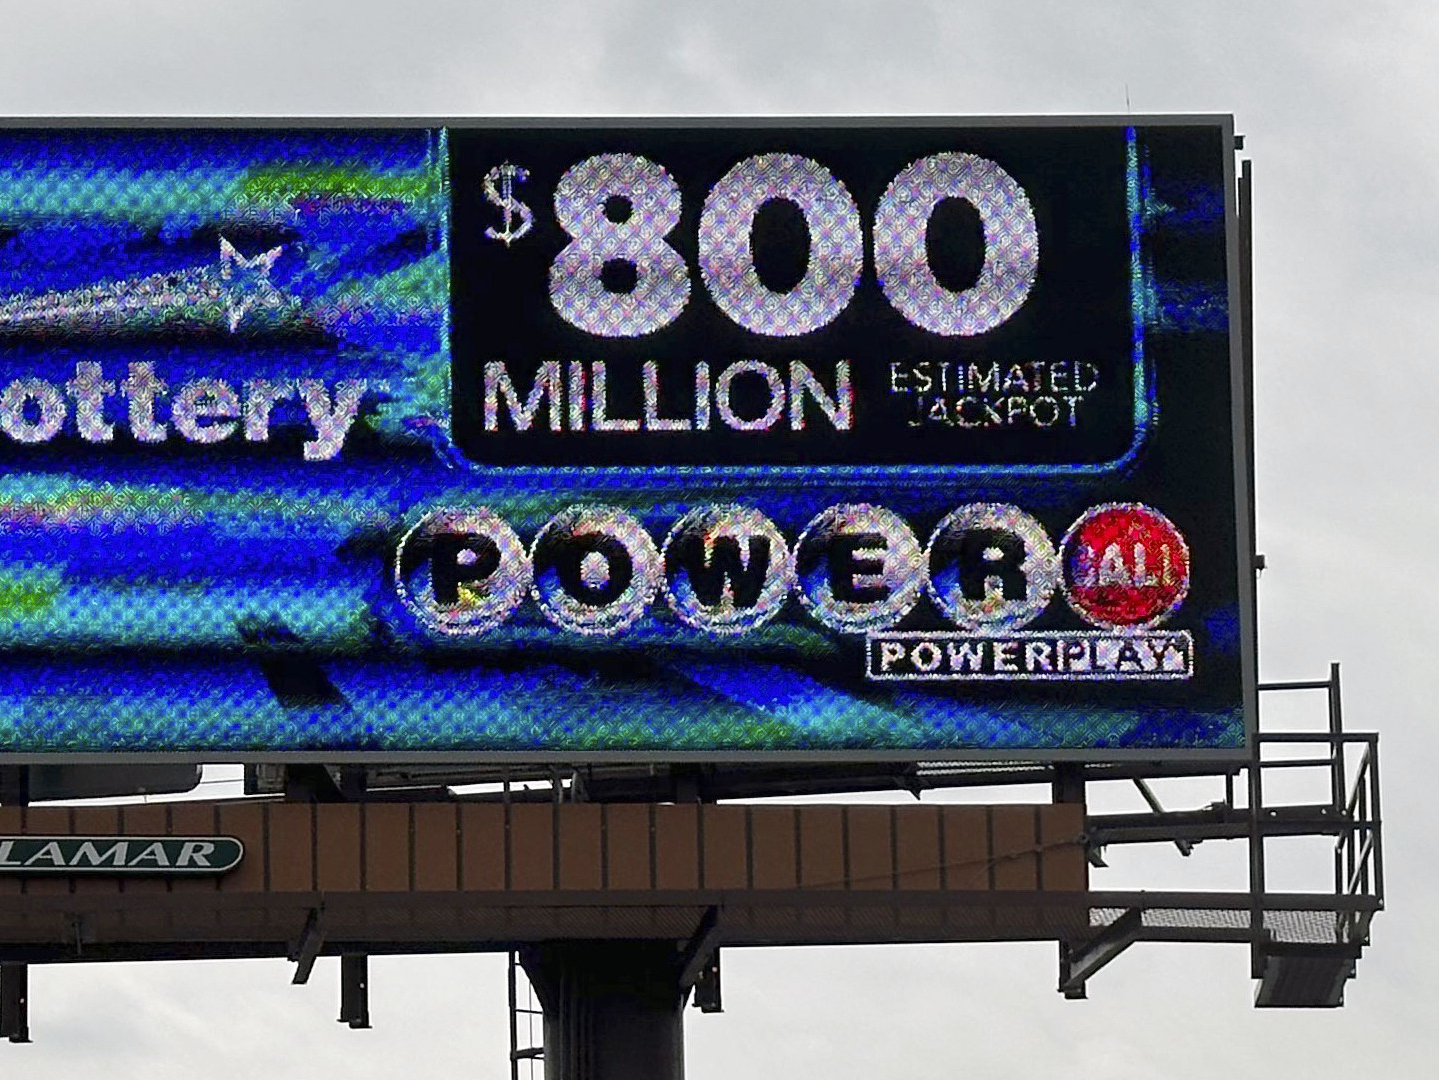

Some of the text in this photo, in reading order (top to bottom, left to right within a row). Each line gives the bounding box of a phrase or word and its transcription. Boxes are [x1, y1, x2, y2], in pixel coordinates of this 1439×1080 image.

[889, 361, 1101, 393] ESTIMATED
[482, 359, 854, 432] MILLION
[907, 396, 1085, 428] JACKPOT
